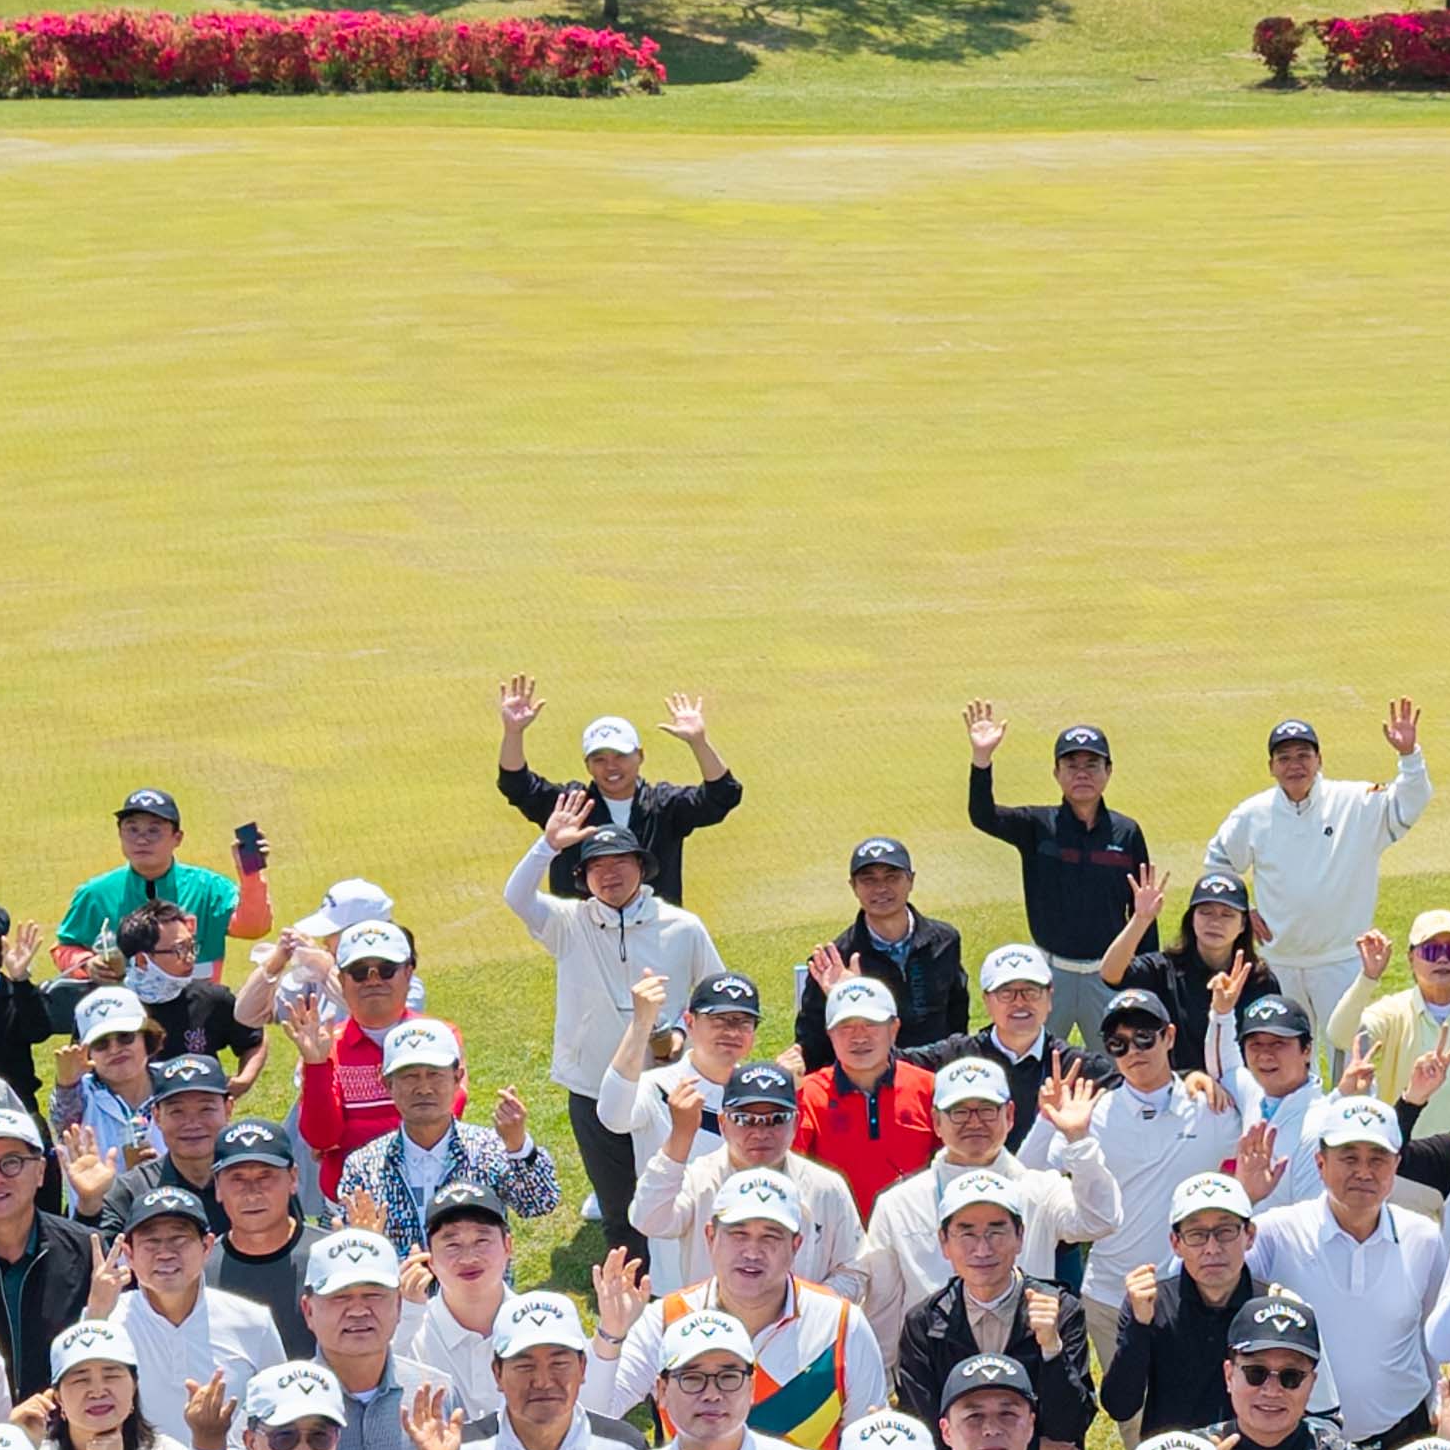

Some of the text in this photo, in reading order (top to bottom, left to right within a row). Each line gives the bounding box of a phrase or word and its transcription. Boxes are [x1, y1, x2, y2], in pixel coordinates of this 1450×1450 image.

[226, 1124, 272, 1142] Callaway
[145, 1189, 193, 1207] Callaway
[740, 1181, 787, 1200] Callaway
[329, 1240, 380, 1257] Callaway
[512, 1302, 563, 1323] Callaway
[1253, 1304, 1306, 1326] Callaway
[680, 1319, 733, 1336] Callaway
[64, 1326, 113, 1349] Callaway
[964, 1358, 1016, 1376] Callaway
[278, 1371, 329, 1390] Callaway
[861, 1422, 916, 1441] Callaway
